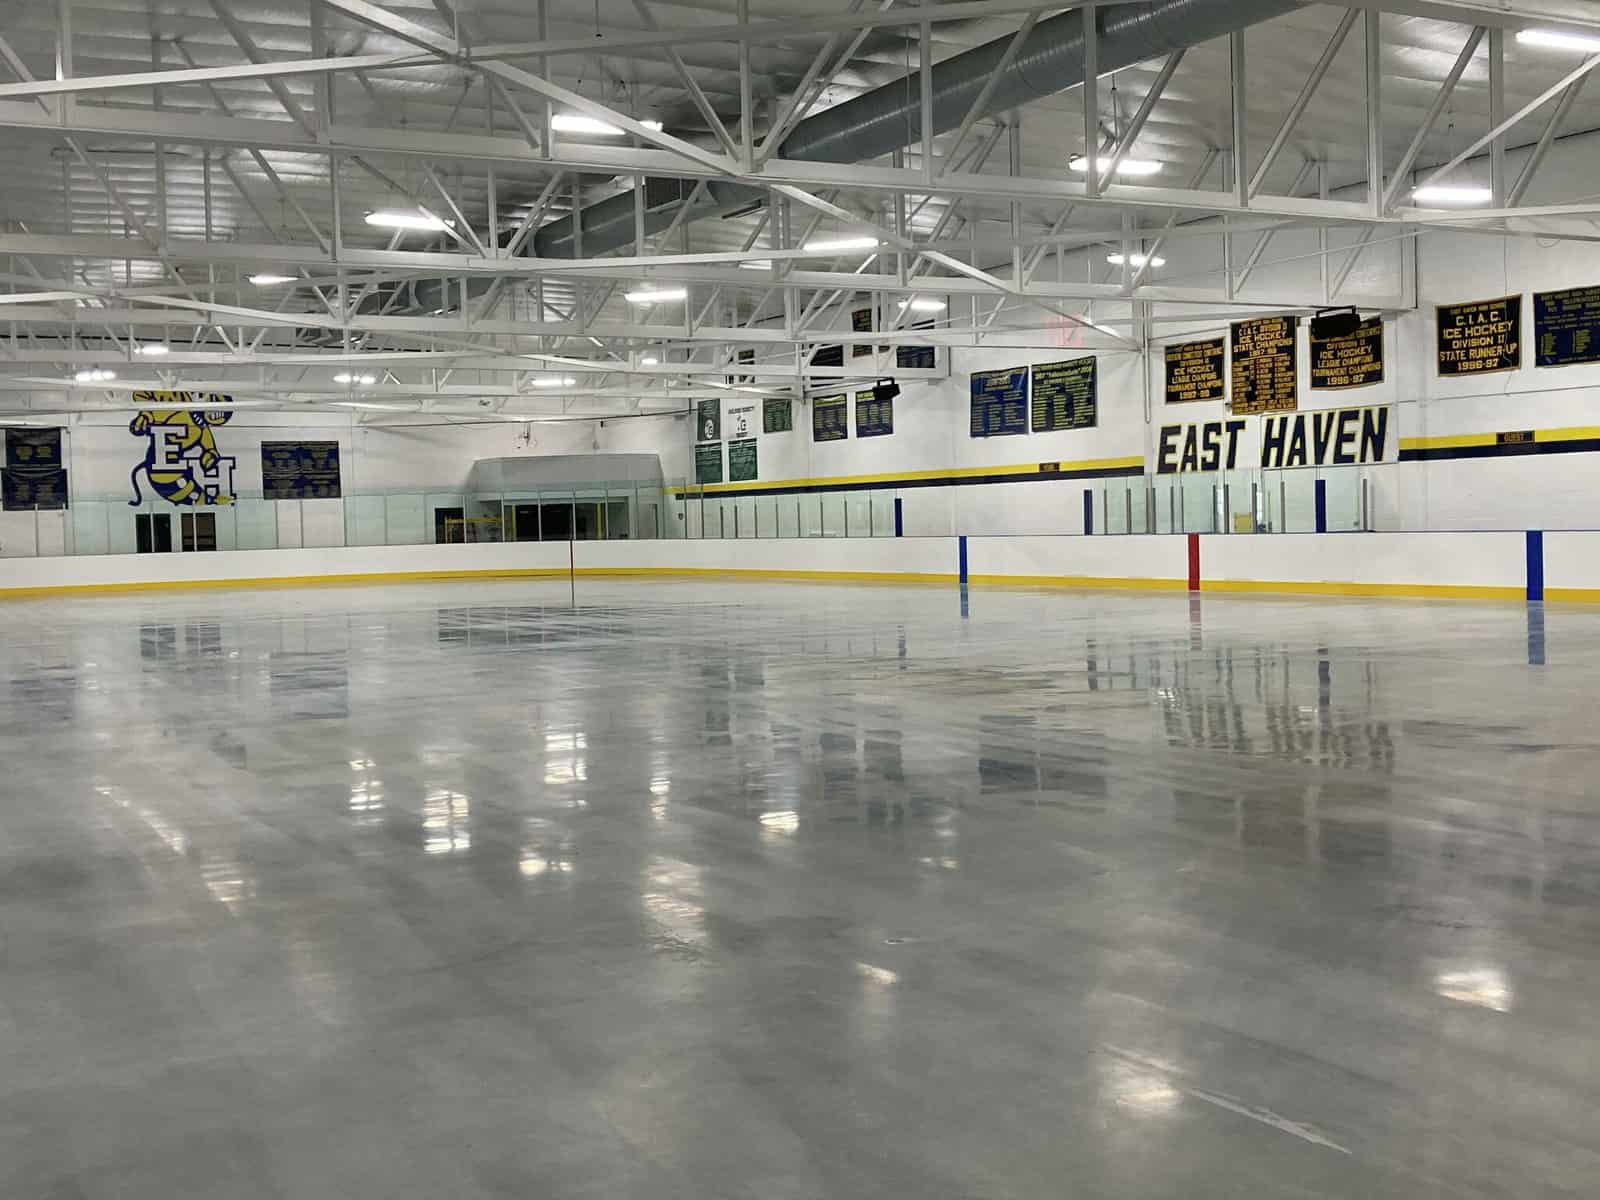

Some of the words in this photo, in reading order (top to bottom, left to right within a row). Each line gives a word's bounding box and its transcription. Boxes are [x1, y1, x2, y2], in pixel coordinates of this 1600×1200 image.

[1254, 330, 1287, 342] HOCKEY
[1443, 328, 1463, 340] ICE
[1465, 320, 1514, 338] HOCKEY
[1452, 336, 1494, 349] DIVISION
[1320, 350, 1335, 360] ICE
[1337, 344, 1372, 359] HOCKEY
[1440, 350, 1467, 361] STATE
[1469, 342, 1518, 360] RUNNER-UP
[1187, 363, 1216, 375] HOCKEY
[1157, 419, 1247, 474] EAST
[1261, 406, 1390, 469] HAVEN
